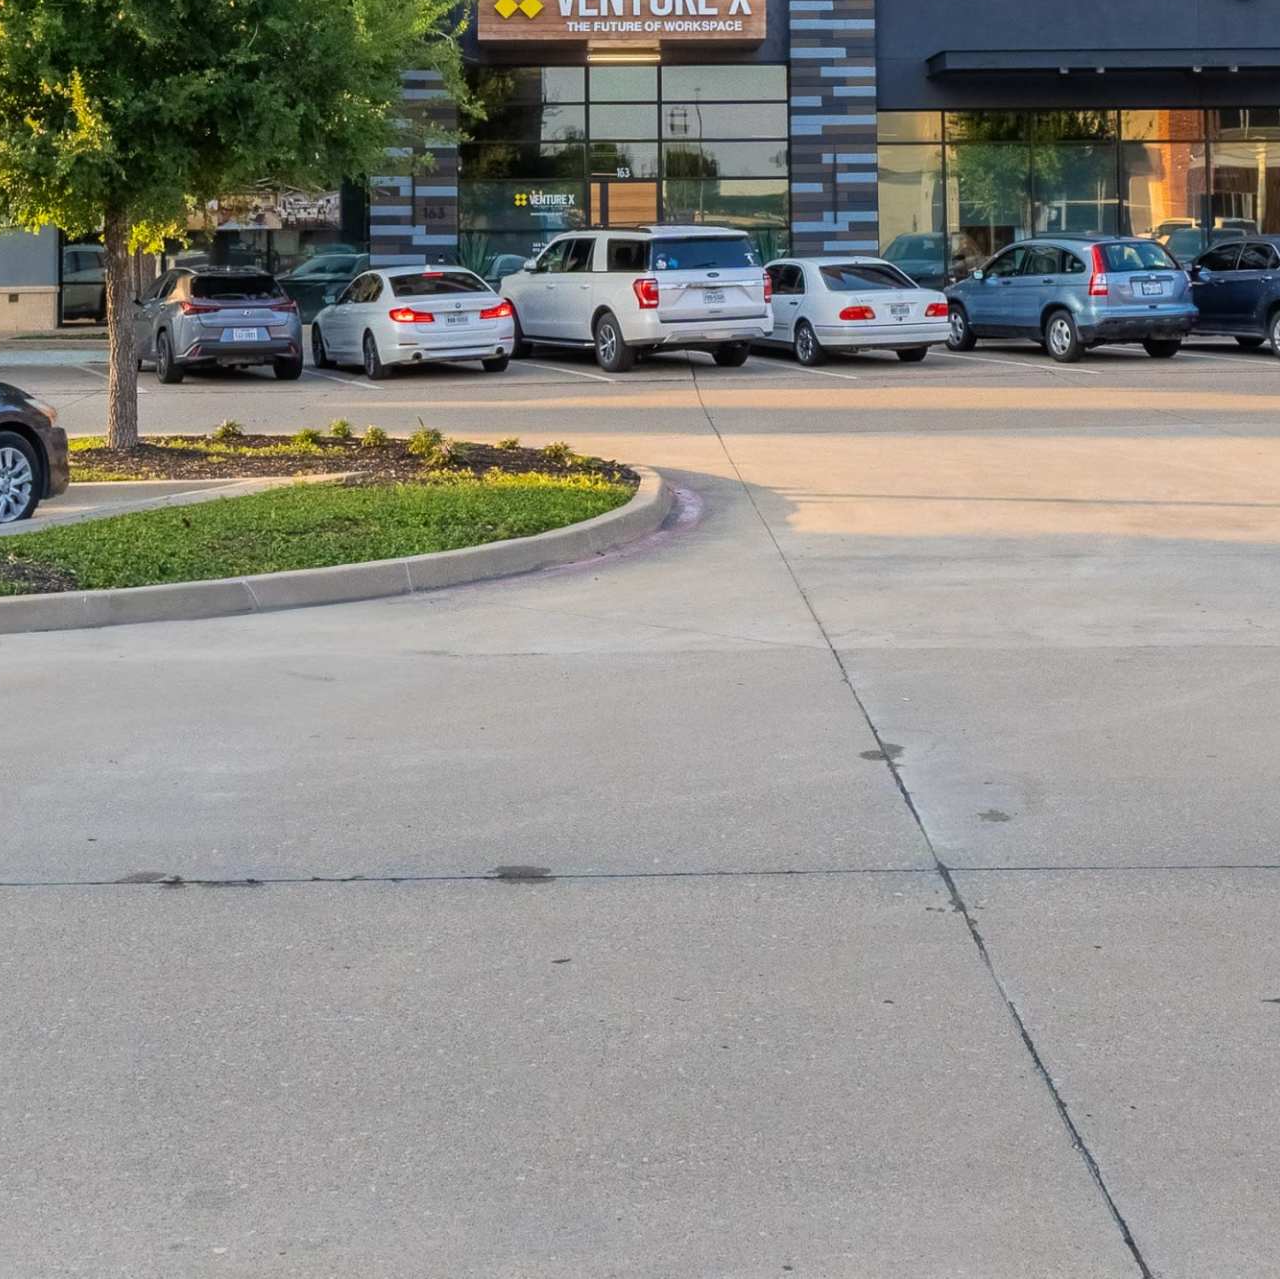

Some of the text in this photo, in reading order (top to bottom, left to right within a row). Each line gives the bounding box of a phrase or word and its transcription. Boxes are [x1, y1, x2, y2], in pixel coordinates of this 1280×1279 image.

[567, 20, 743, 32] THE FUTURE OF WORKSPACE
[616, 167, 630, 178] 163
[529, 193, 575, 205] VENTURE X
